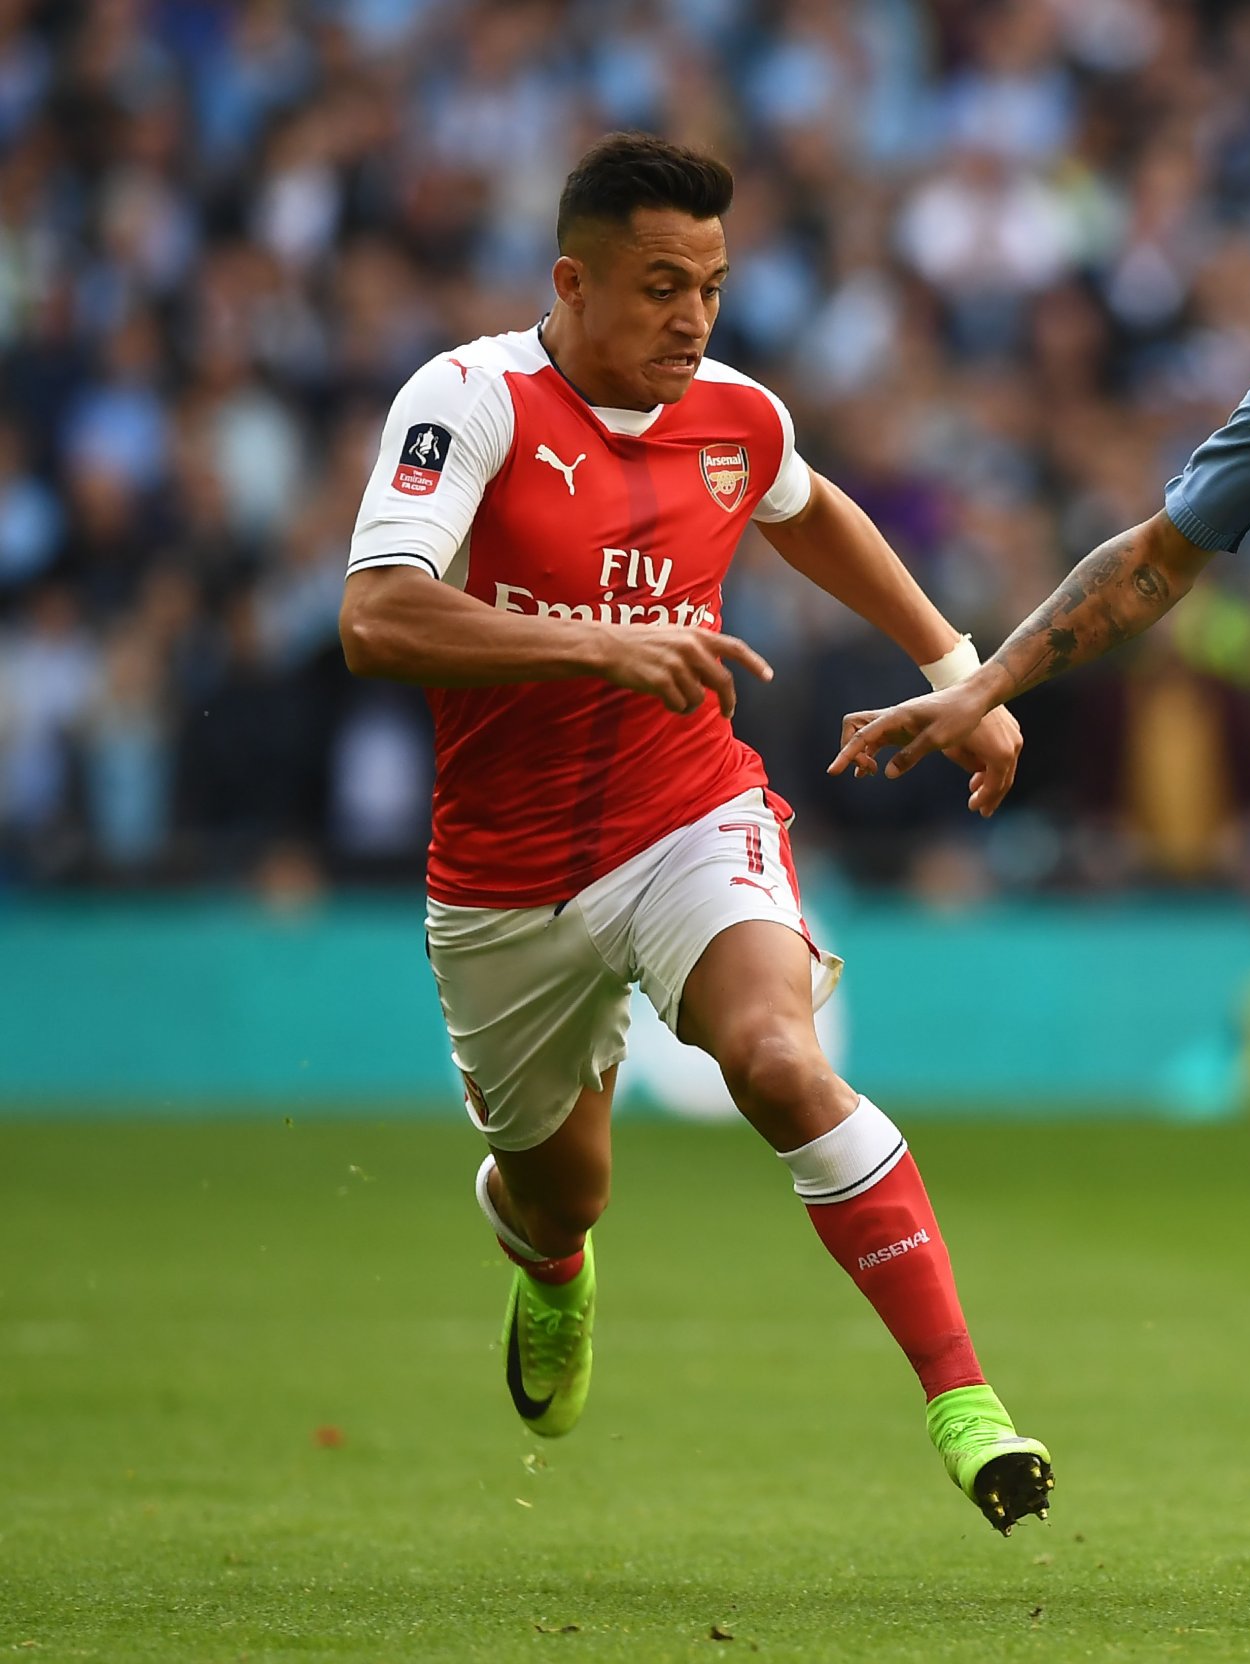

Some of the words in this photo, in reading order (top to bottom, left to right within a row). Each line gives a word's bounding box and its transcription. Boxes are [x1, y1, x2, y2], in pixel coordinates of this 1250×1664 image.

[400, 473, 433, 486] Emirates
[706, 453, 742, 467] Arsenal
[600, 547, 672, 597] Fly
[718, 823, 764, 875] 7
[858, 1228, 930, 1270] ARSENAL
